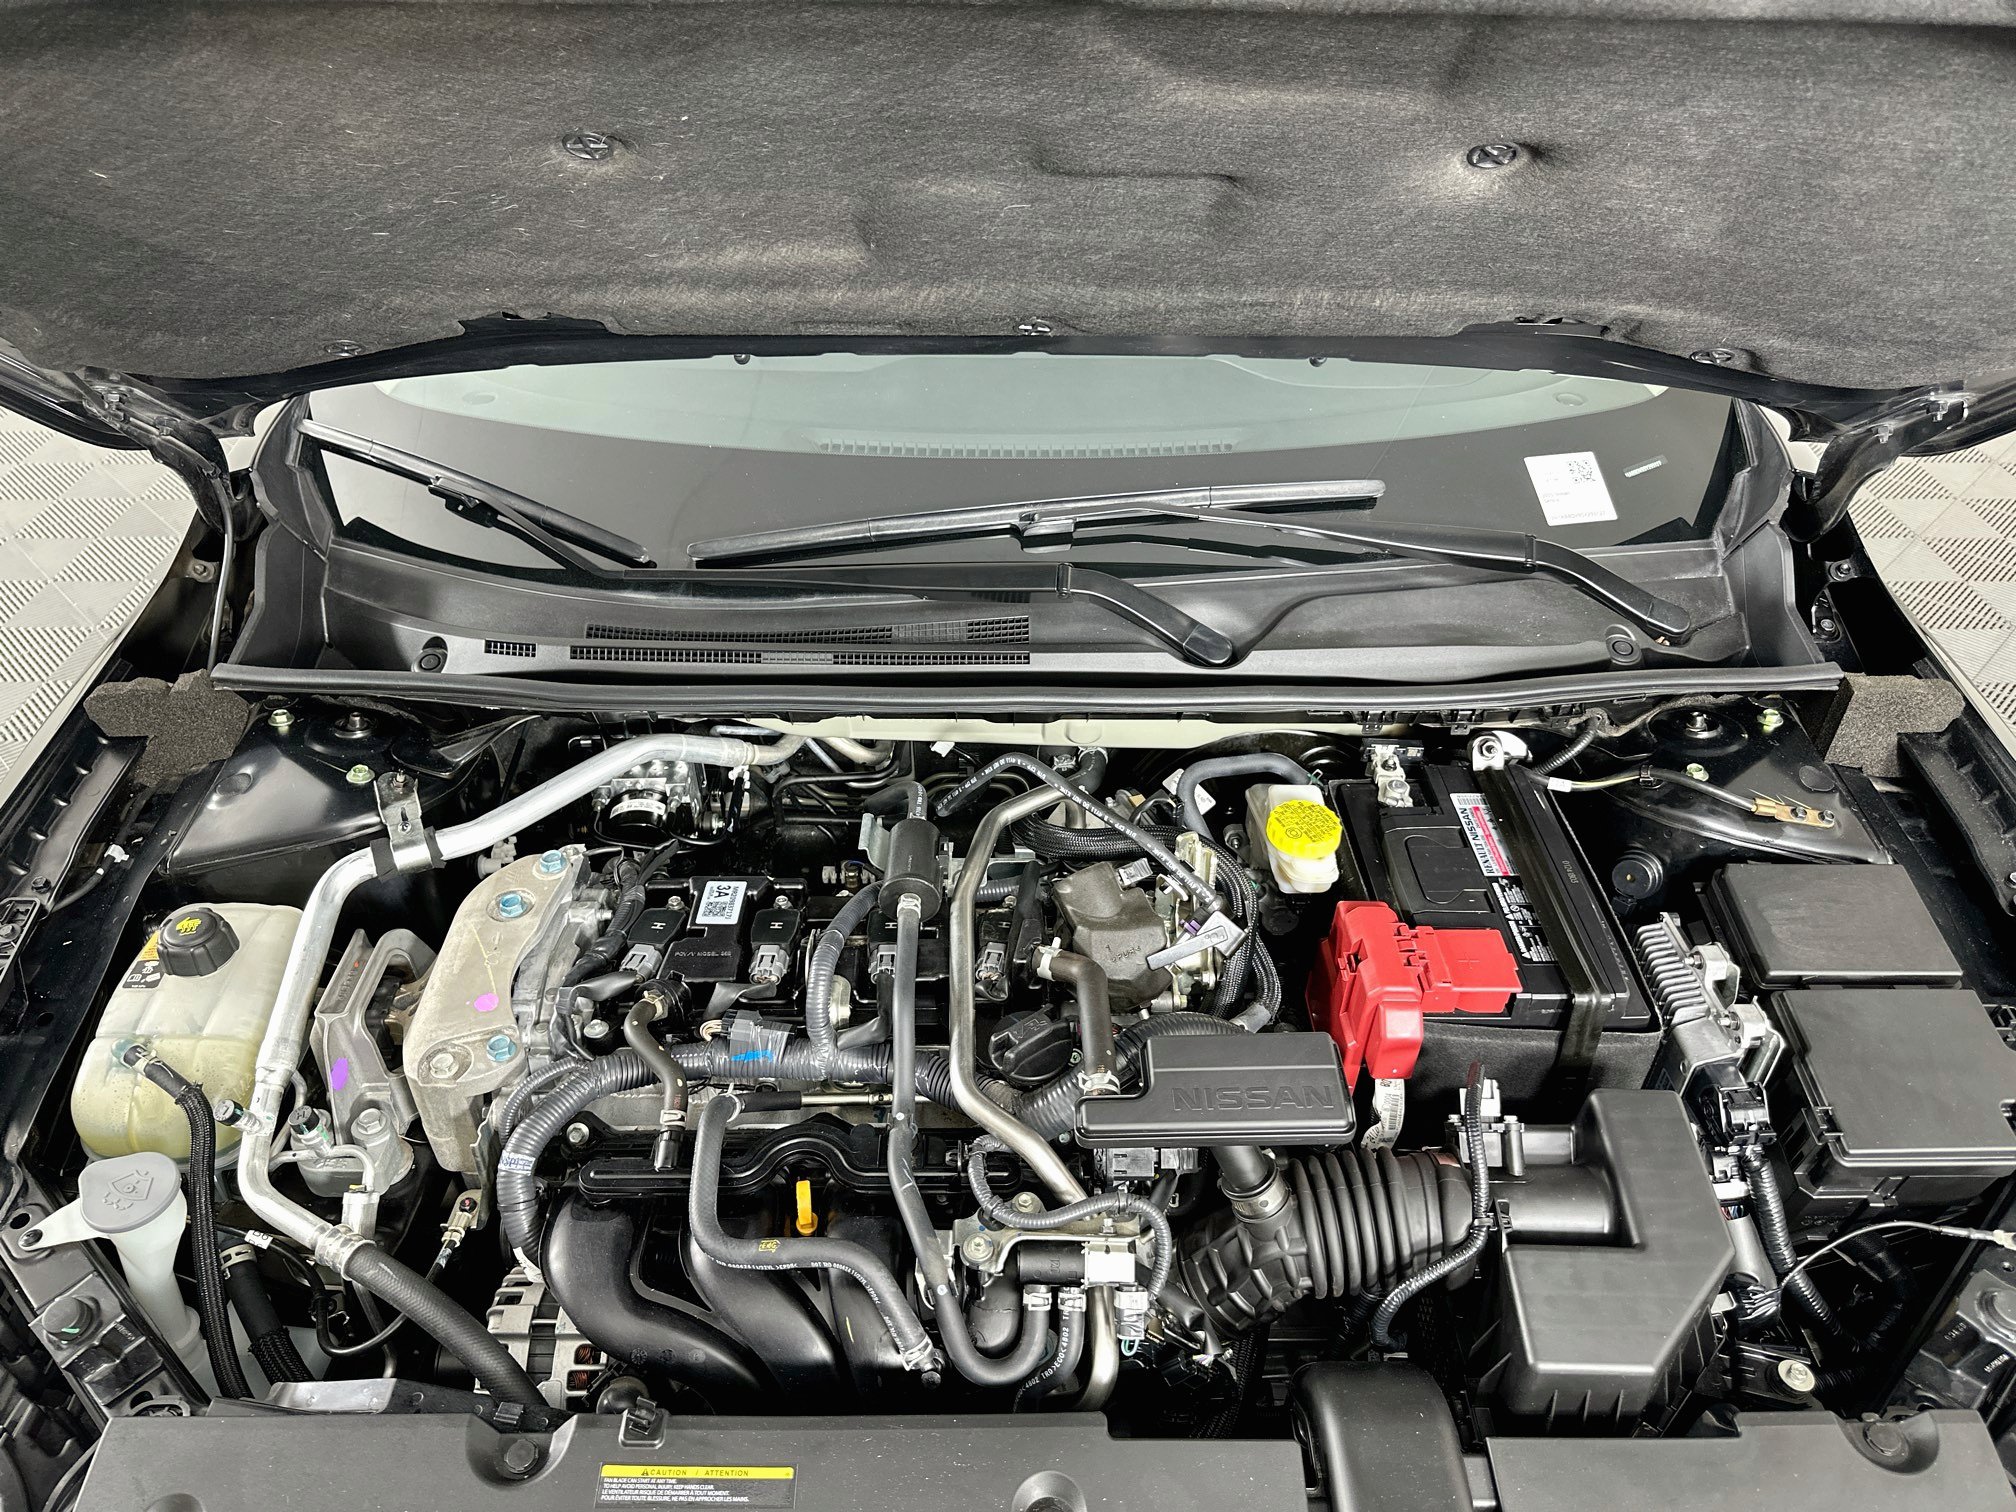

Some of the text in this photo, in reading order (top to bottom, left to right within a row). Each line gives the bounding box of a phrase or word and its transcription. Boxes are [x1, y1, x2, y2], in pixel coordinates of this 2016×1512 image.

[1459, 807, 1481, 841] NISSAN
[715, 884, 726, 899] 3A
[1171, 1085, 1335, 1111] NISSAN
[704, 1469, 749, 1477] ATTENTION
